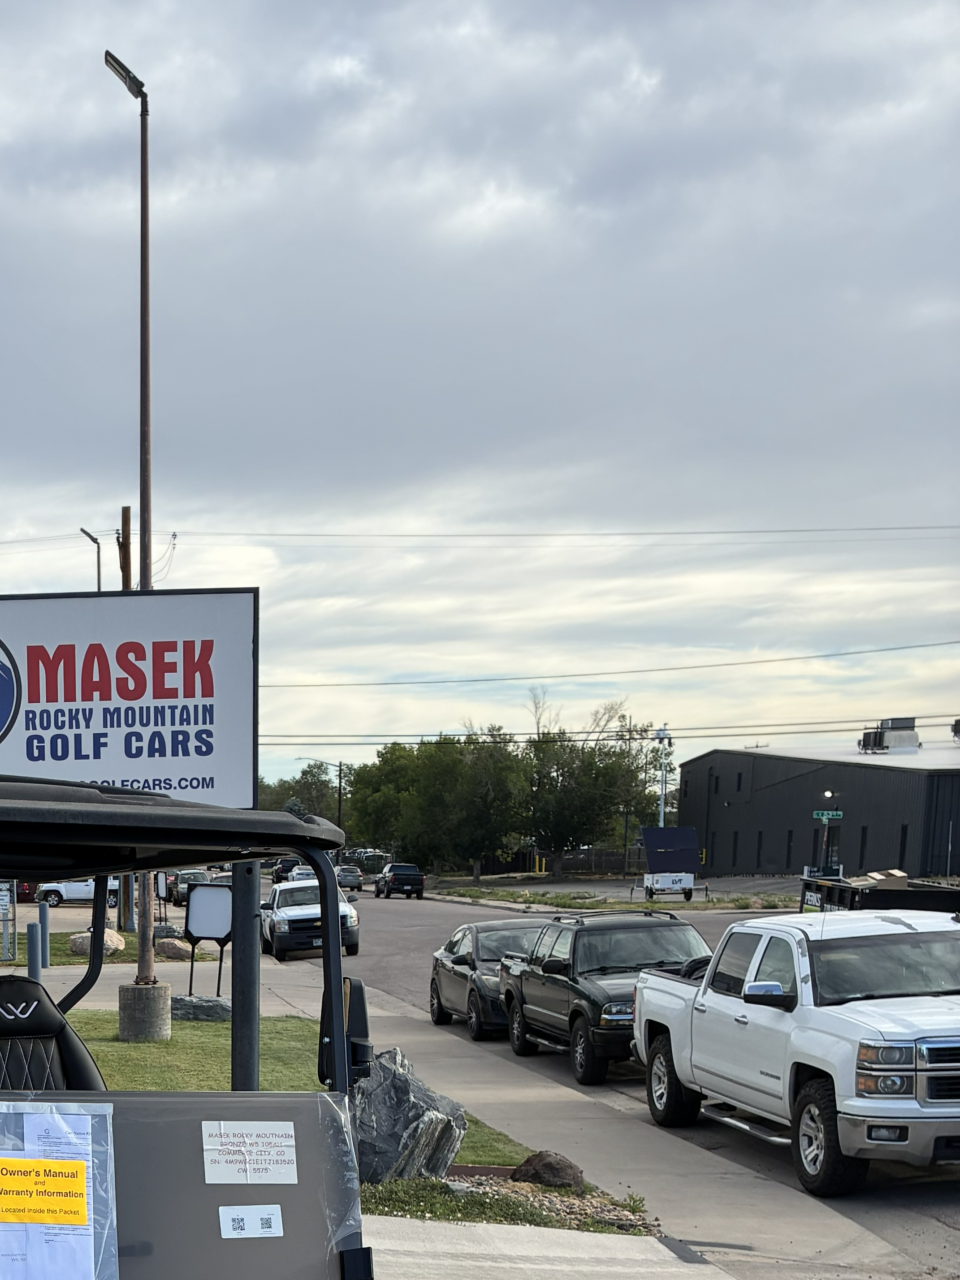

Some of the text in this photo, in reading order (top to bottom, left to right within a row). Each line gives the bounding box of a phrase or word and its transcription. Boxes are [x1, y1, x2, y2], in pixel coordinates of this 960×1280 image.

[26, 639, 215, 704] MASEK
[24, 703, 215, 731] ROCKY MOUNTAIN
[25, 728, 215, 762] GOLF CARS
[80, 777, 215, 791] FCARS.COM
[0, 1167, 78, 1179] Owner's Manual
[36, 1189, 84, 1199] Information
[59, 1208, 80, 1216] Packet
